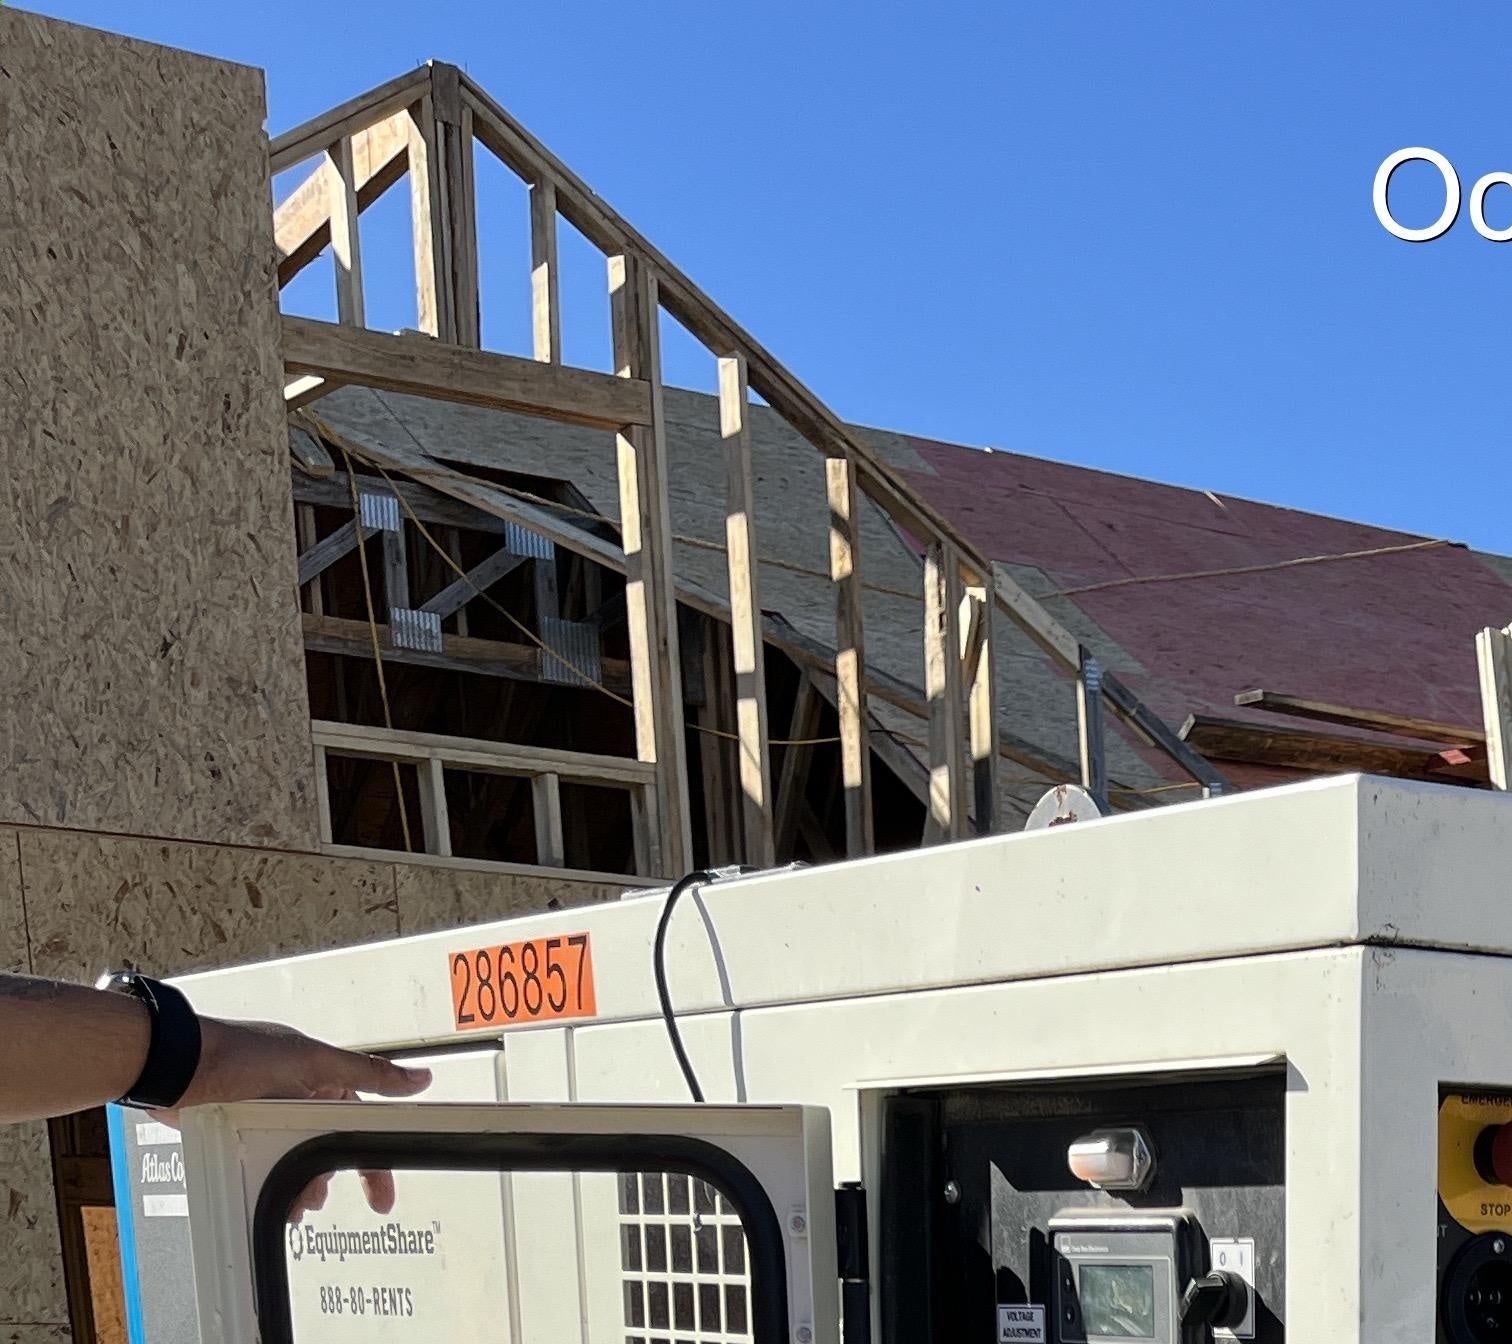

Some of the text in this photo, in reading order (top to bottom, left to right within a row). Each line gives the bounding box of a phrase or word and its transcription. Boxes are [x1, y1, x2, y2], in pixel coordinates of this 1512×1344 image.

[453, 935, 588, 1025] 286857
[1481, 1204, 1512, 1217] STOP
[319, 1285, 414, 1318] 888-80-RENTS
[1007, 1311, 1034, 1322] VOLTAGE
[1003, 1328, 1042, 1339] ADJUSTMENT
